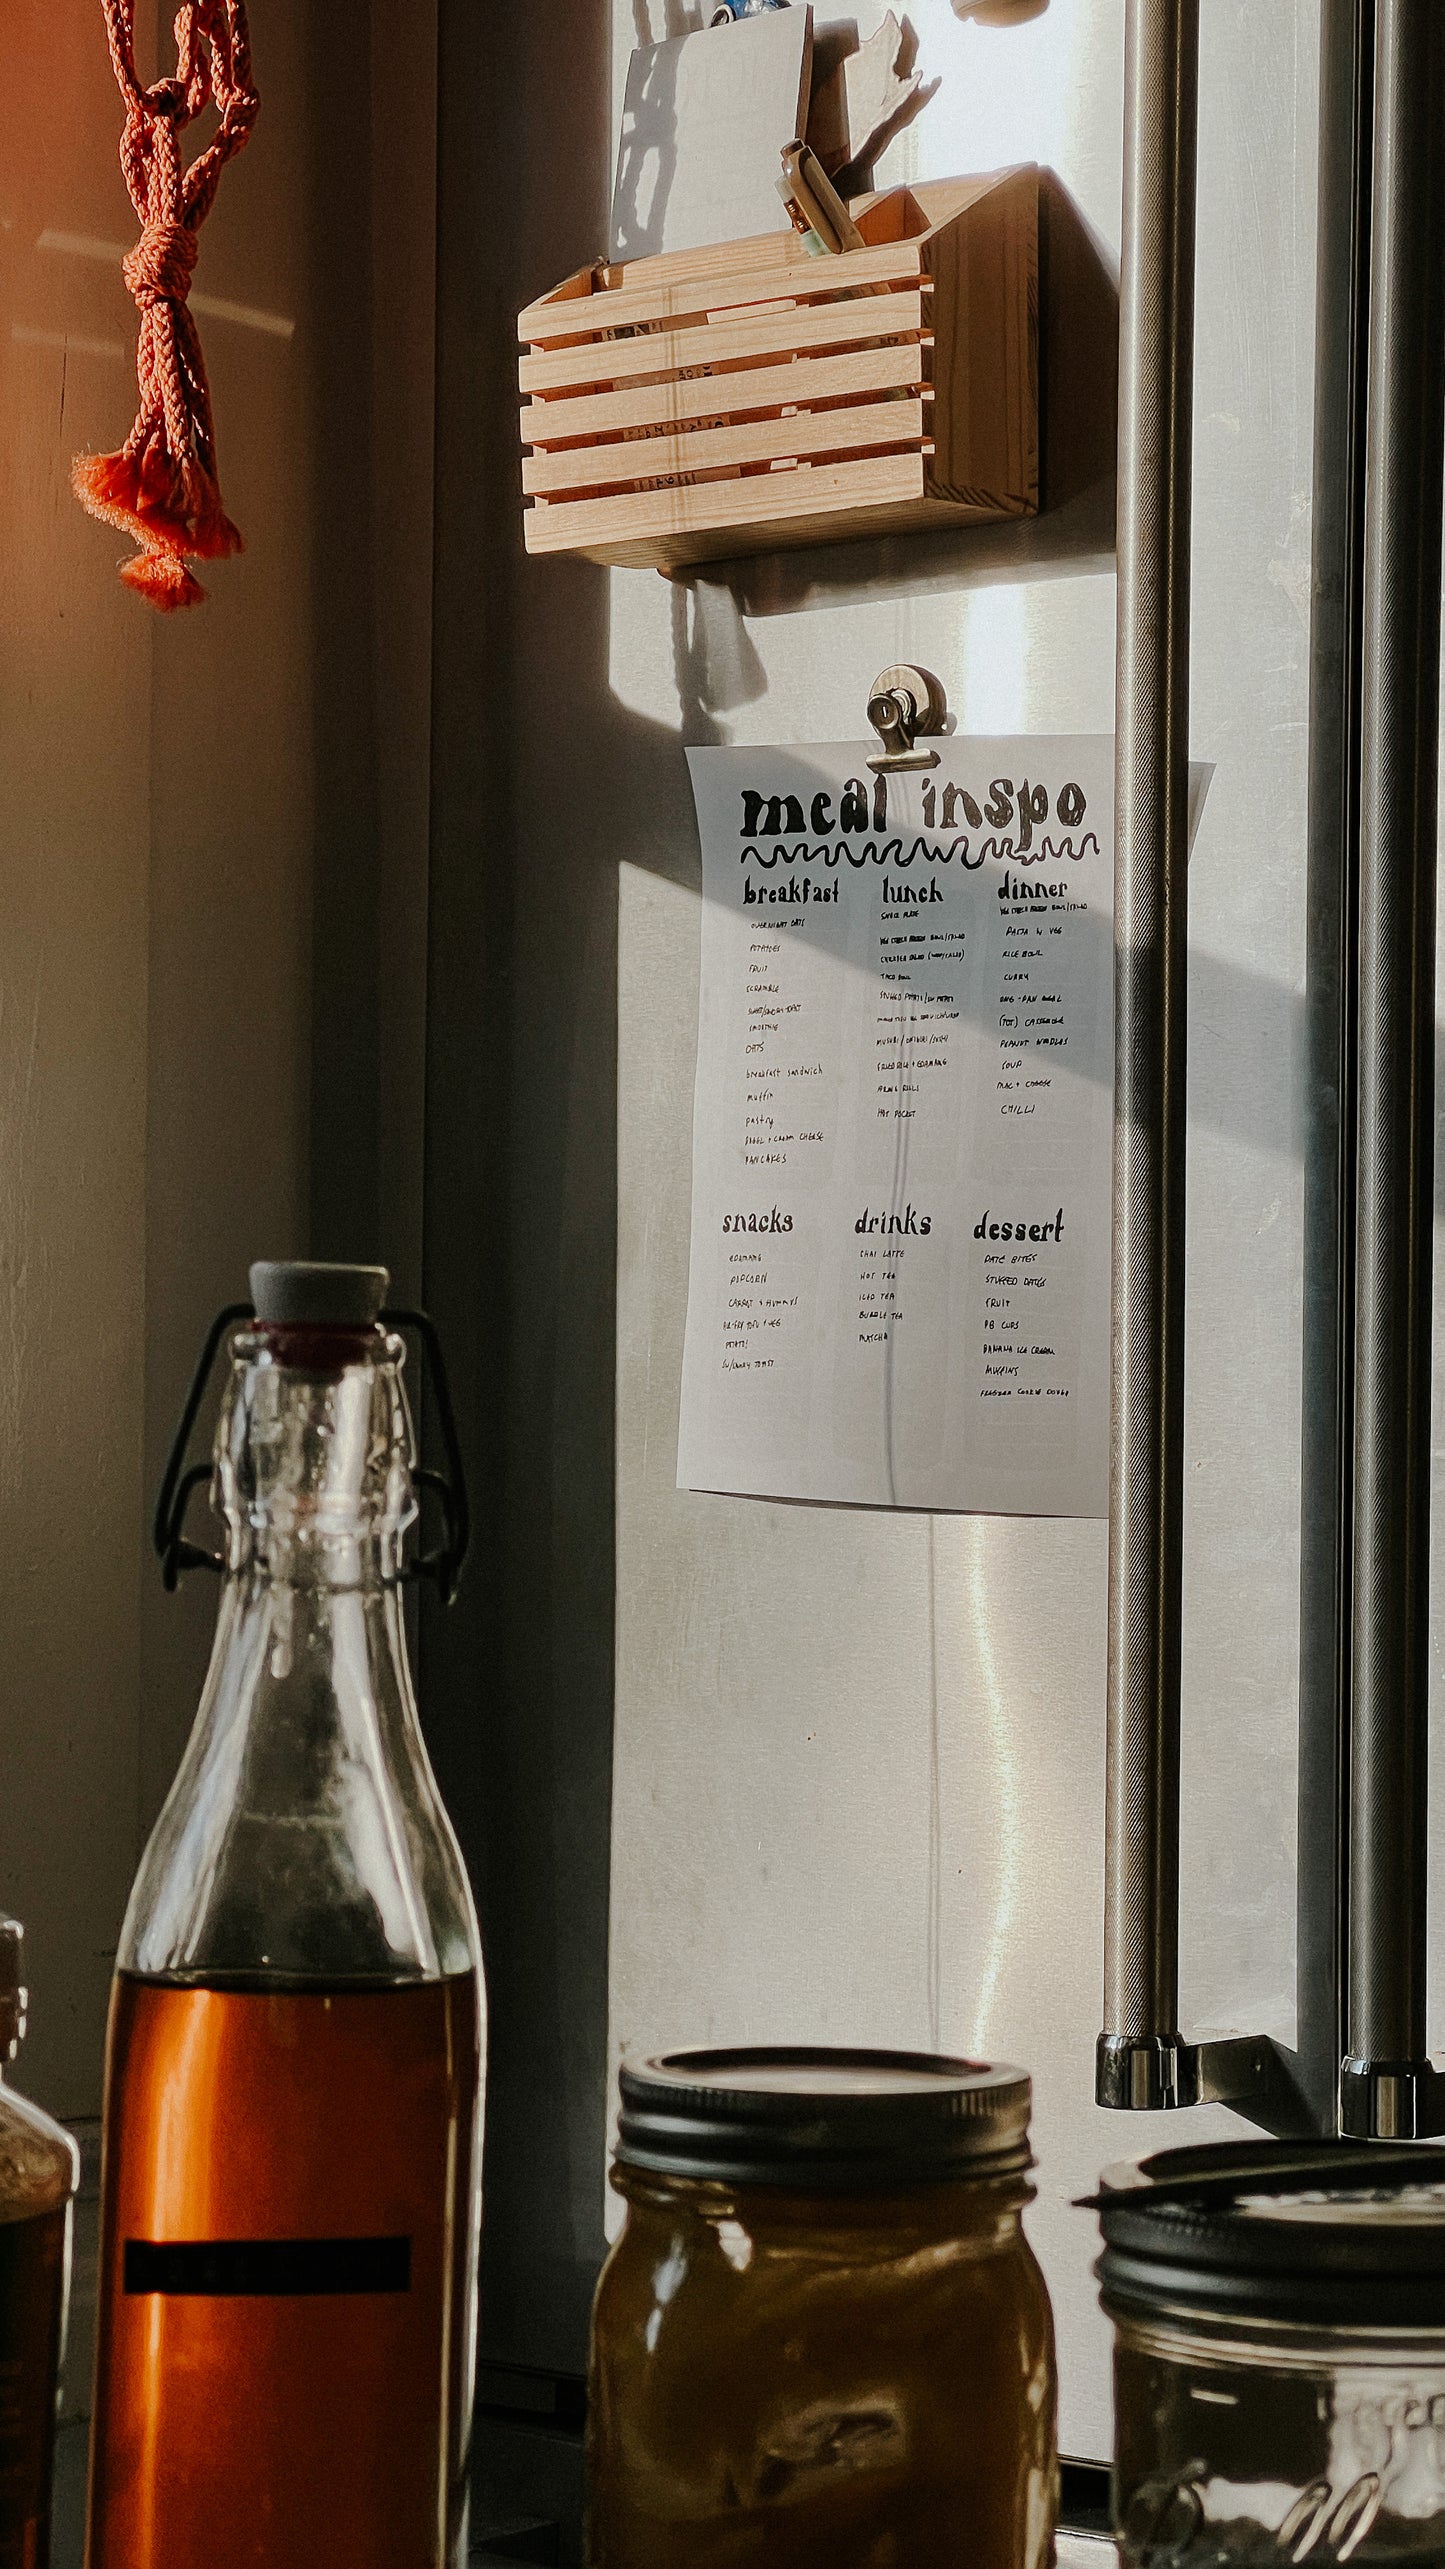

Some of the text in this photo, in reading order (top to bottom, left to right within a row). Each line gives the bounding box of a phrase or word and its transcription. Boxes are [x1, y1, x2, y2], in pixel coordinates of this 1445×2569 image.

[740, 774, 1087, 851] meal inspo
[743, 875, 839, 904] breakfast
[882, 875, 943, 903] lunch
[998, 870, 1068, 899] dinner
[1002, 950, 1018, 958] RICE
[749, 964, 767, 973] FRUIT
[1003, 973, 1029, 981] CURRY
[745, 1041, 764, 1054] OATS
[1000, 1040, 1029, 1048] PEANUT
[1002, 1060, 1022, 1070] SOUP
[746, 1063, 823, 1079] breakfast sandwich
[746, 1088, 774, 1103] muffin
[1000, 1104, 1035, 1115] CHILLI
[745, 1115, 774, 1130] pastry
[745, 1153, 787, 1165] PANCAKES
[722, 1204, 794, 1234] snacks
[854, 1202, 932, 1236] drinks
[973, 1207, 1065, 1243] dessert
[860, 1250, 905, 1258] CHAI LATTE
[984, 1254, 1038, 1264] DATE BITES
[730, 1272, 768, 1286] POPCORN
[860, 1272, 896, 1280] HOT TEA
[880, 1292, 895, 1301] TEA
[985, 1298, 1010, 1308] FRUIT
[890, 1312, 903, 1321] TEA
[984, 1319, 1019, 1330] PB CUPS
[858, 1332, 888, 1344] MATCHA
[983, 1344, 1013, 1355] BANANA
